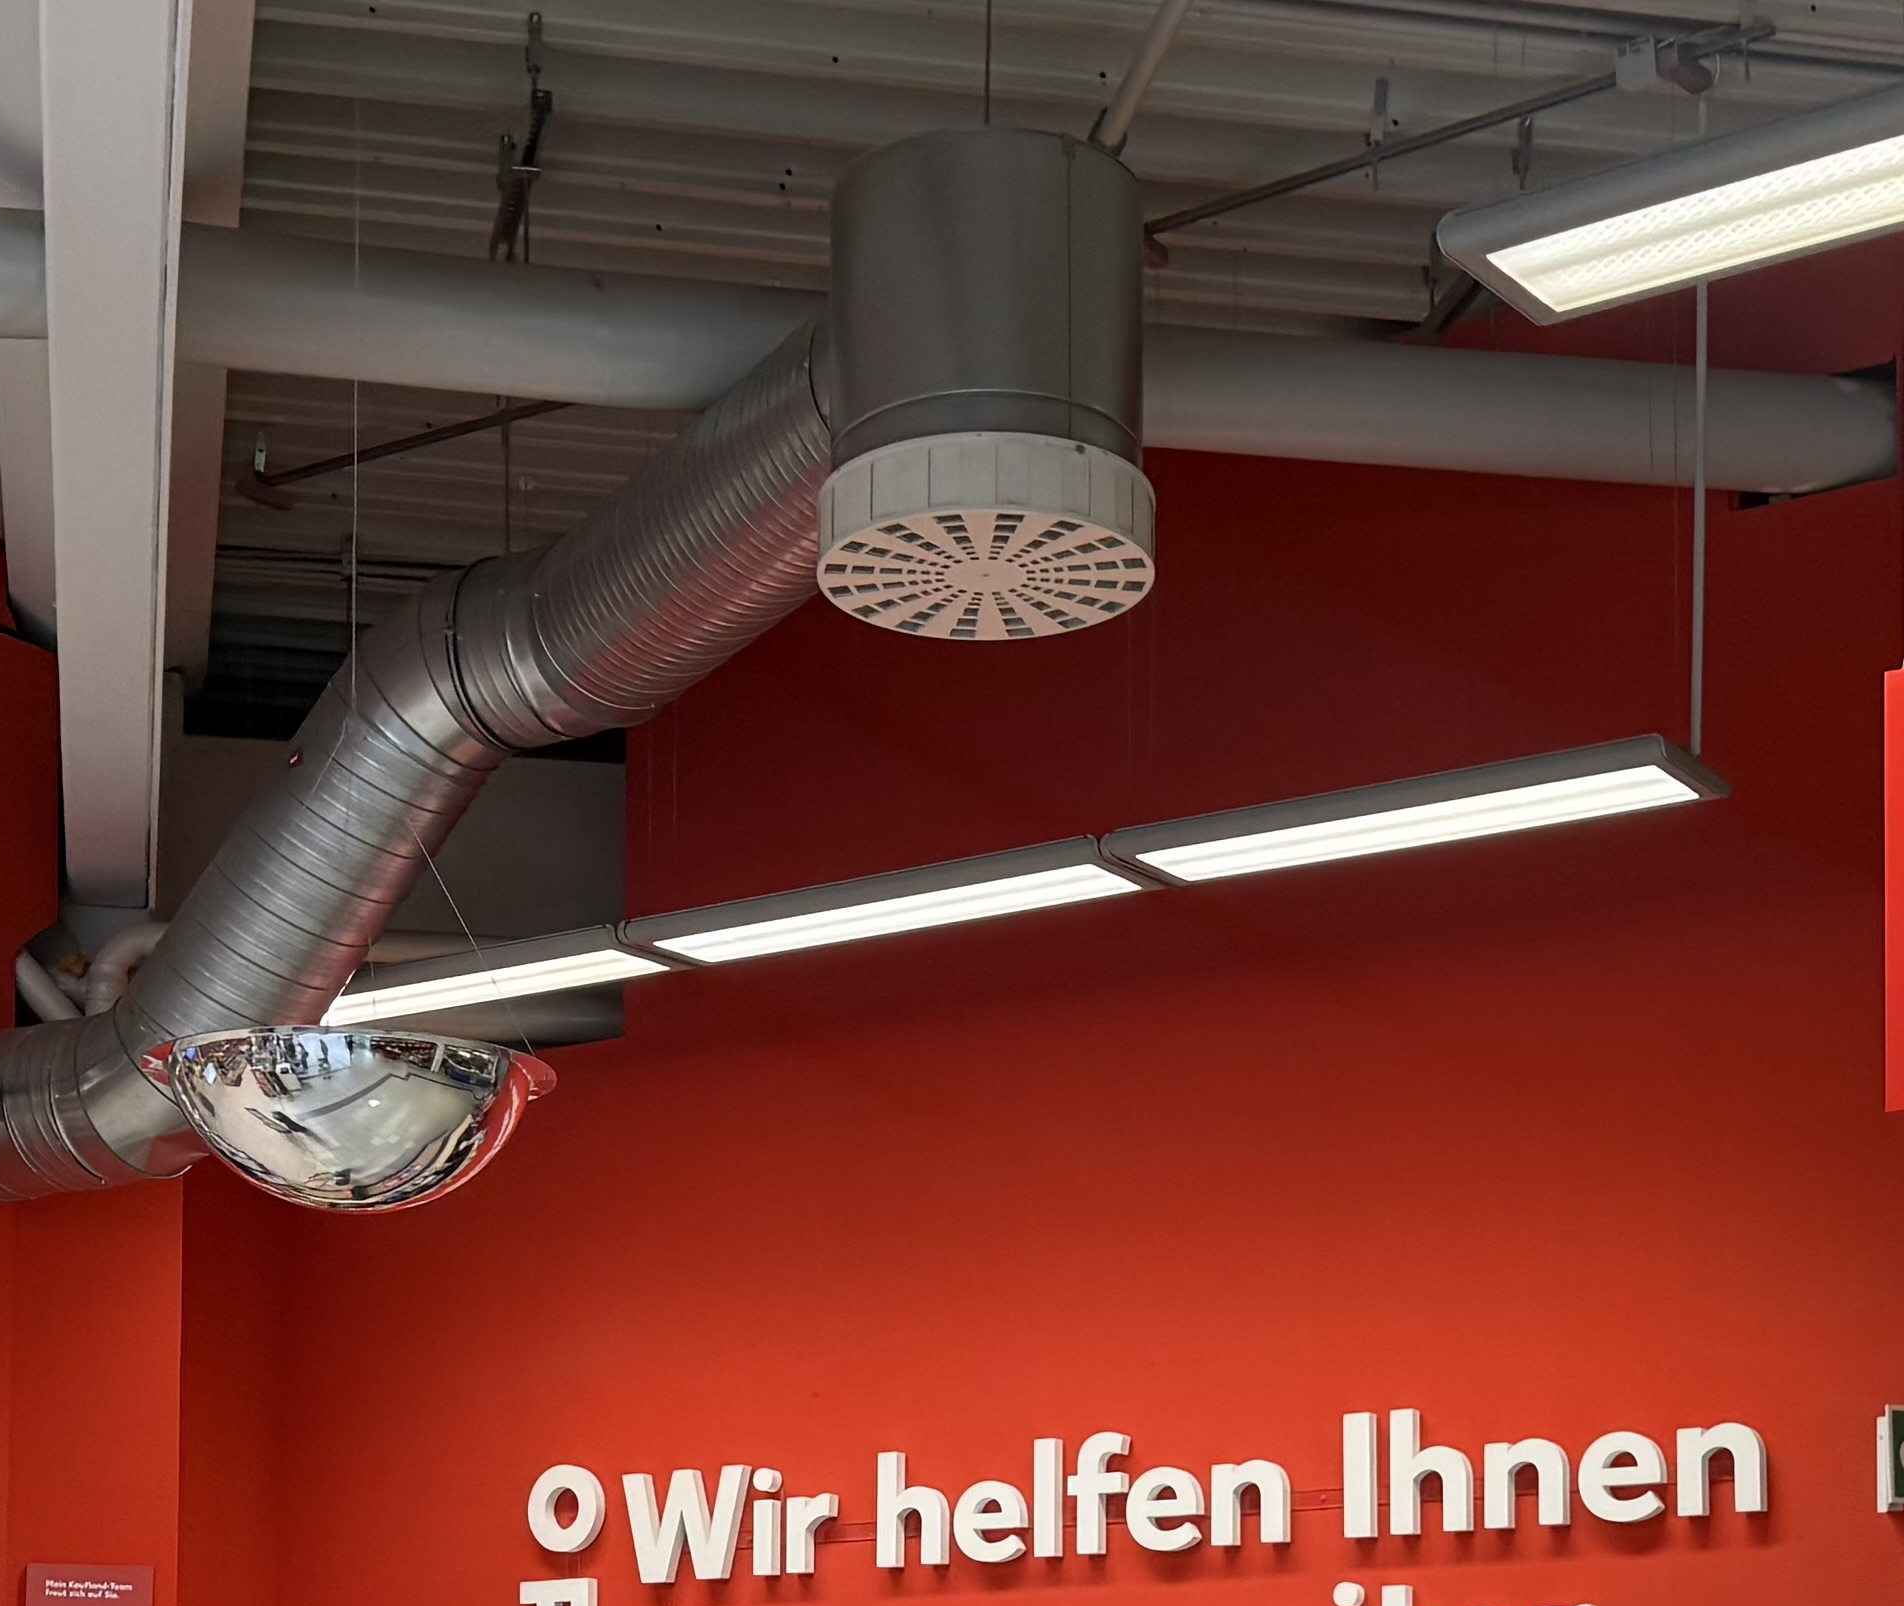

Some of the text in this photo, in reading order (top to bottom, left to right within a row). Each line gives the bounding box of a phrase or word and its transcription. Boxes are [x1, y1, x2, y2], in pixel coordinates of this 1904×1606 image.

[622, 1407, 1769, 1586] Wir helfen Ihnen
